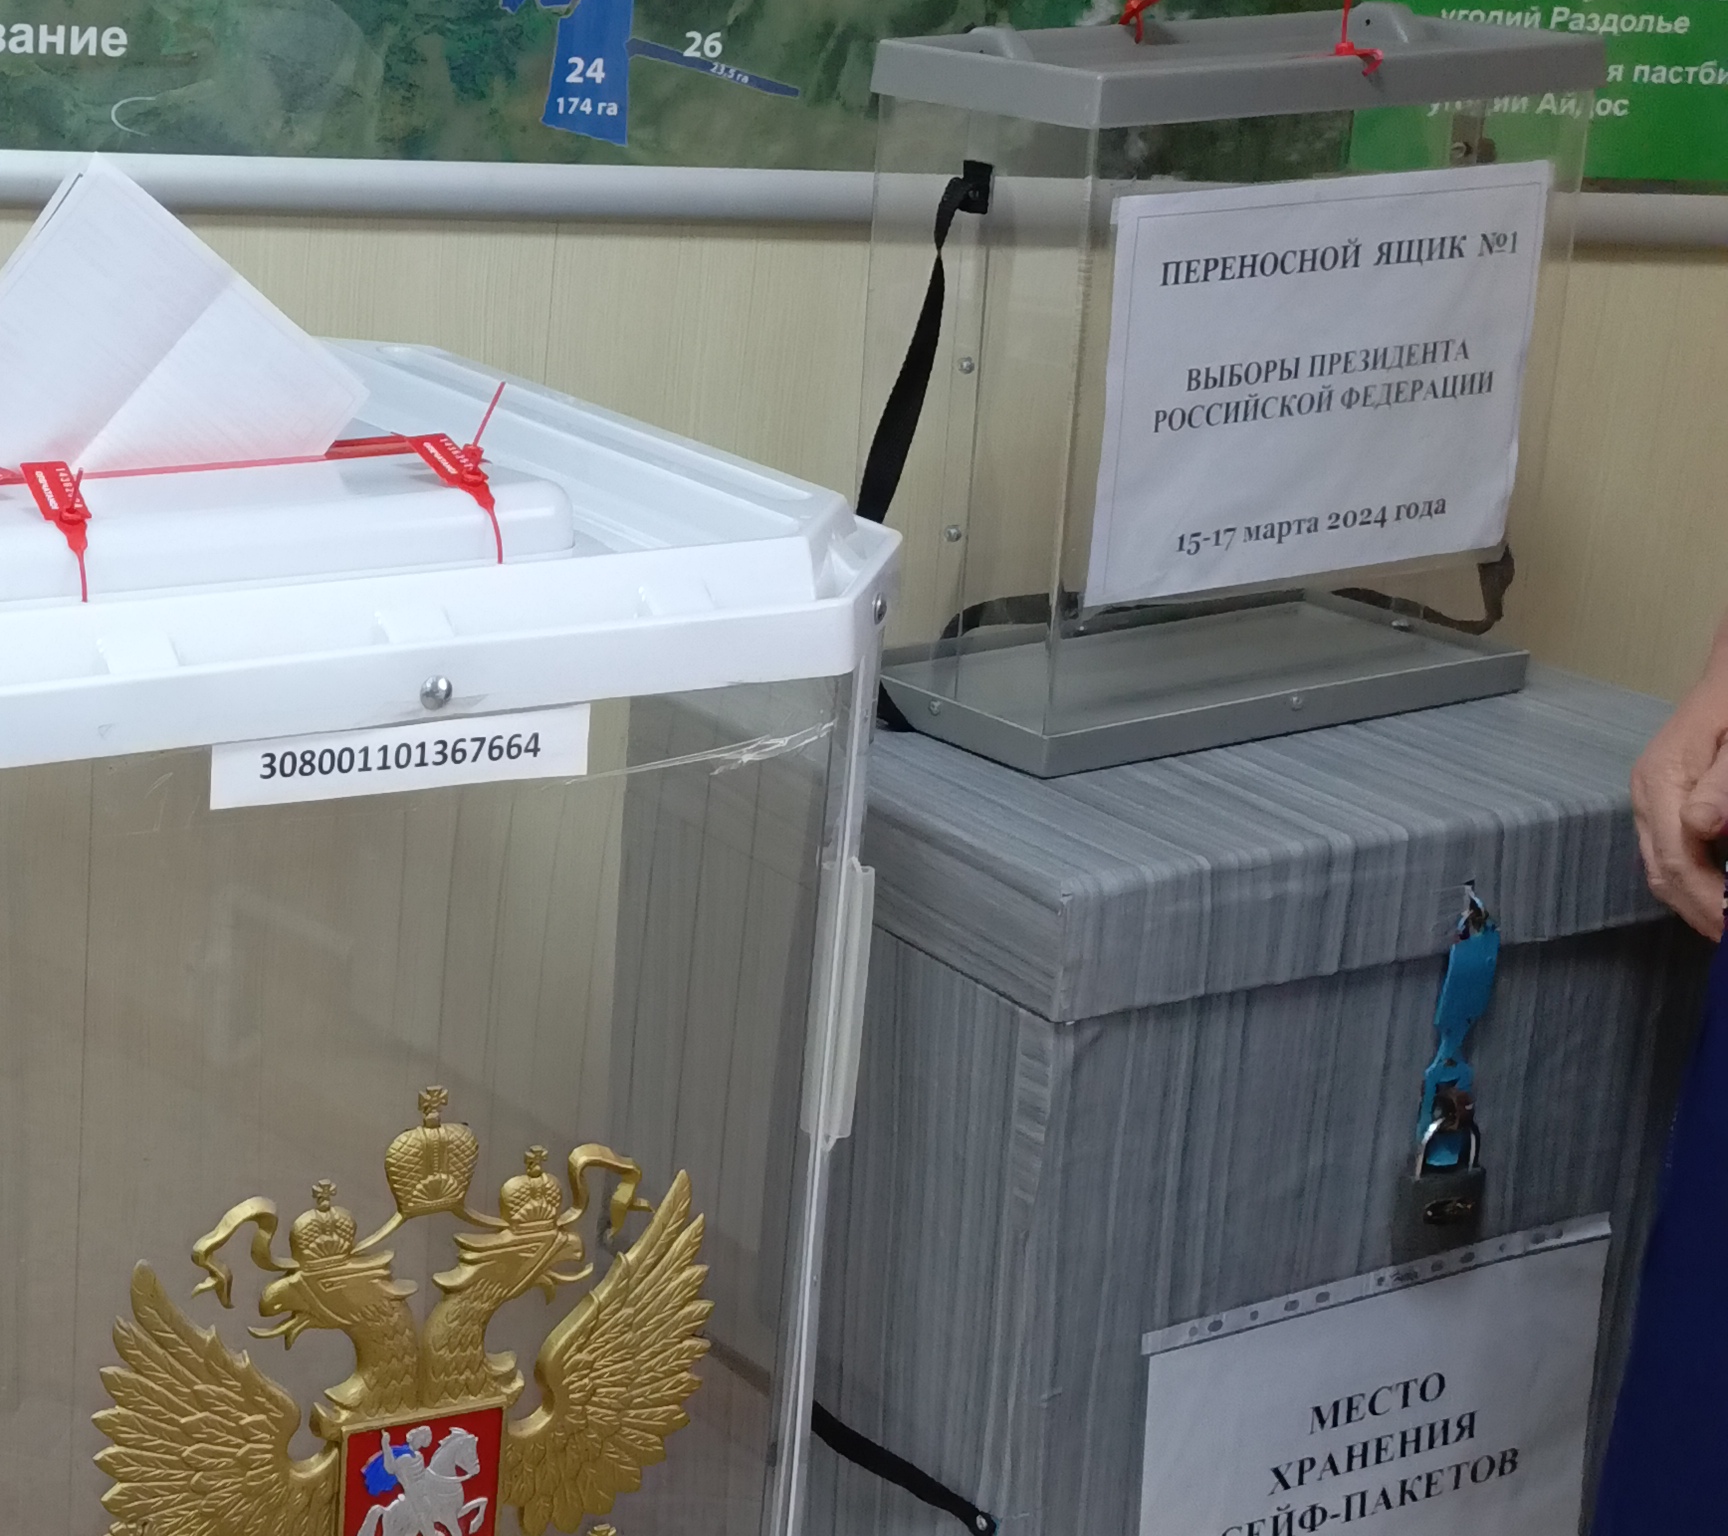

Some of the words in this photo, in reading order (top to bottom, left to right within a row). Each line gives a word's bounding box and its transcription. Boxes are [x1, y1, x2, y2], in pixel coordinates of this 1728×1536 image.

[682, 30, 723, 58] 26
[1549, 5, 1691, 36] Раздолье
[565, 57, 606, 84] 24
[556, 96, 592, 115] 174
[597, 101, 618, 116] га
[1159, 237, 1362, 286] ПЕРЕНОСНОЙ
[1373, 234, 1468, 267] ЯЩИК
[1477, 231, 1518, 257] №1
[1185, 356, 1301, 392] ВЫБОРЫ
[1306, 337, 1470, 380] ПРЕЗИДЕНТА
[1153, 384, 1334, 433] РОССИЙСКОЙ
[1339, 370, 1495, 411] ФЕДЕРАЦИИ
[1175, 526, 1238, 556] 15-17
[1242, 511, 1320, 544] марта
[1326, 504, 1388, 531] 2024
[1394, 497, 1447, 523] года
[259, 731, 542, 780] 308001101367664
[1309, 1371, 1447, 1435] МЕСТО
[1267, 1409, 1479, 1496] ХРАНЕНИЯ
